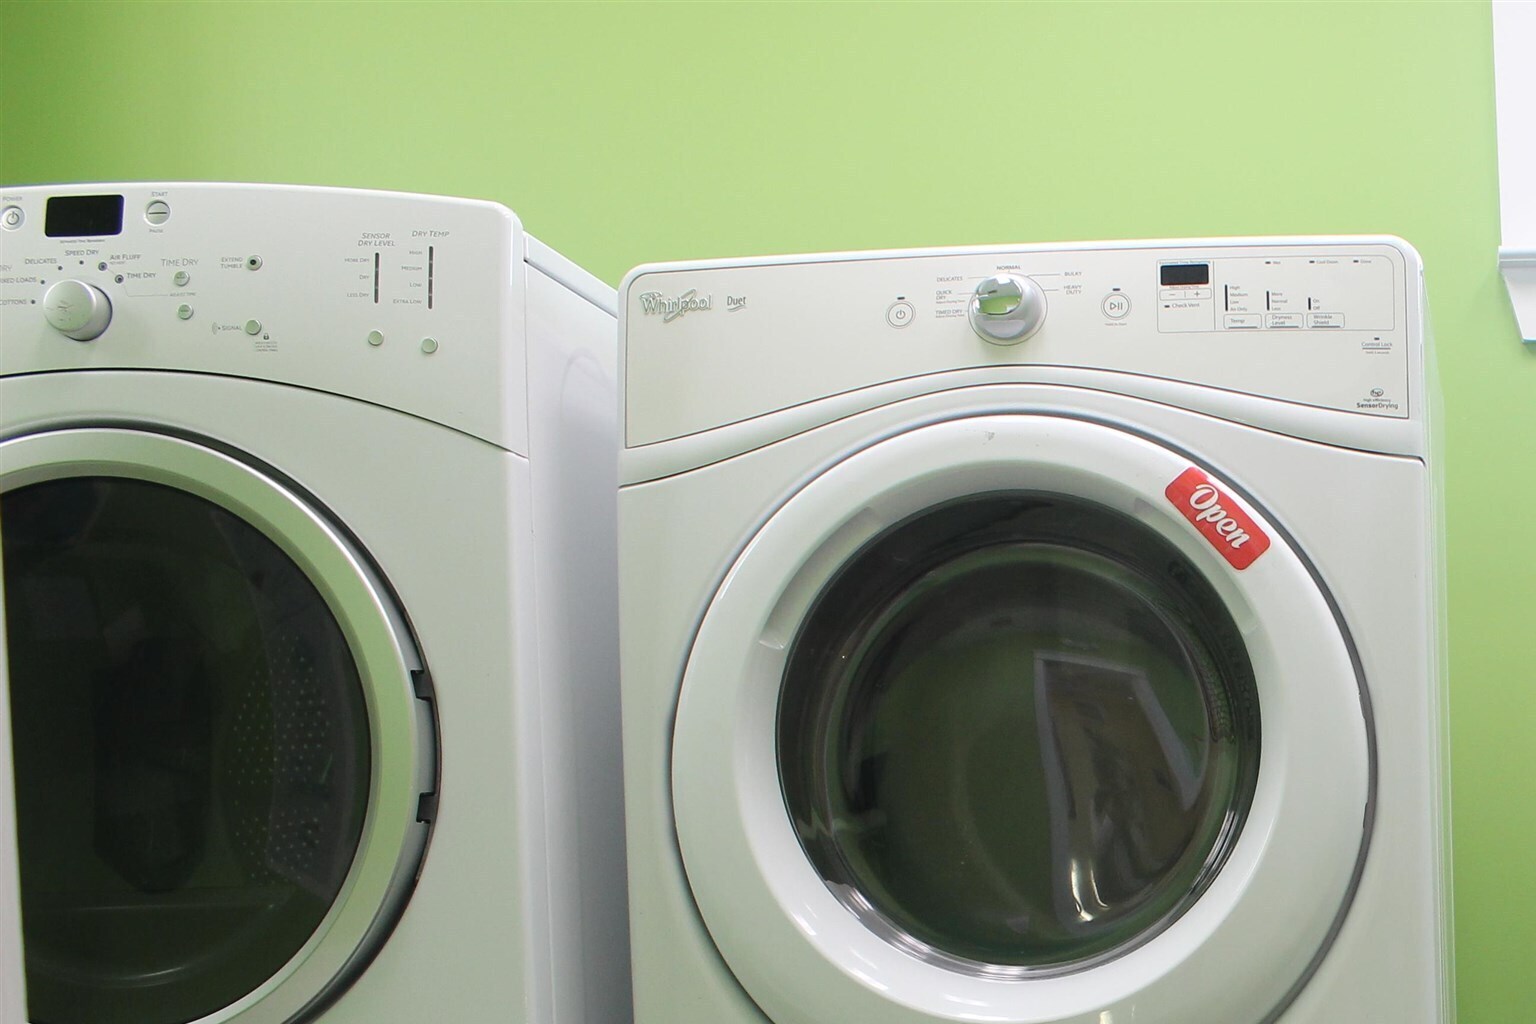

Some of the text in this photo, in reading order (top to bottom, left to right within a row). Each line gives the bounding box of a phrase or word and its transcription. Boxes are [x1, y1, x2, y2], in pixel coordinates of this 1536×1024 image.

[182, 258, 198, 266] DRY
[640, 292, 746, 319] Whirlpool Duet
[1190, 484, 1250, 549] Open
